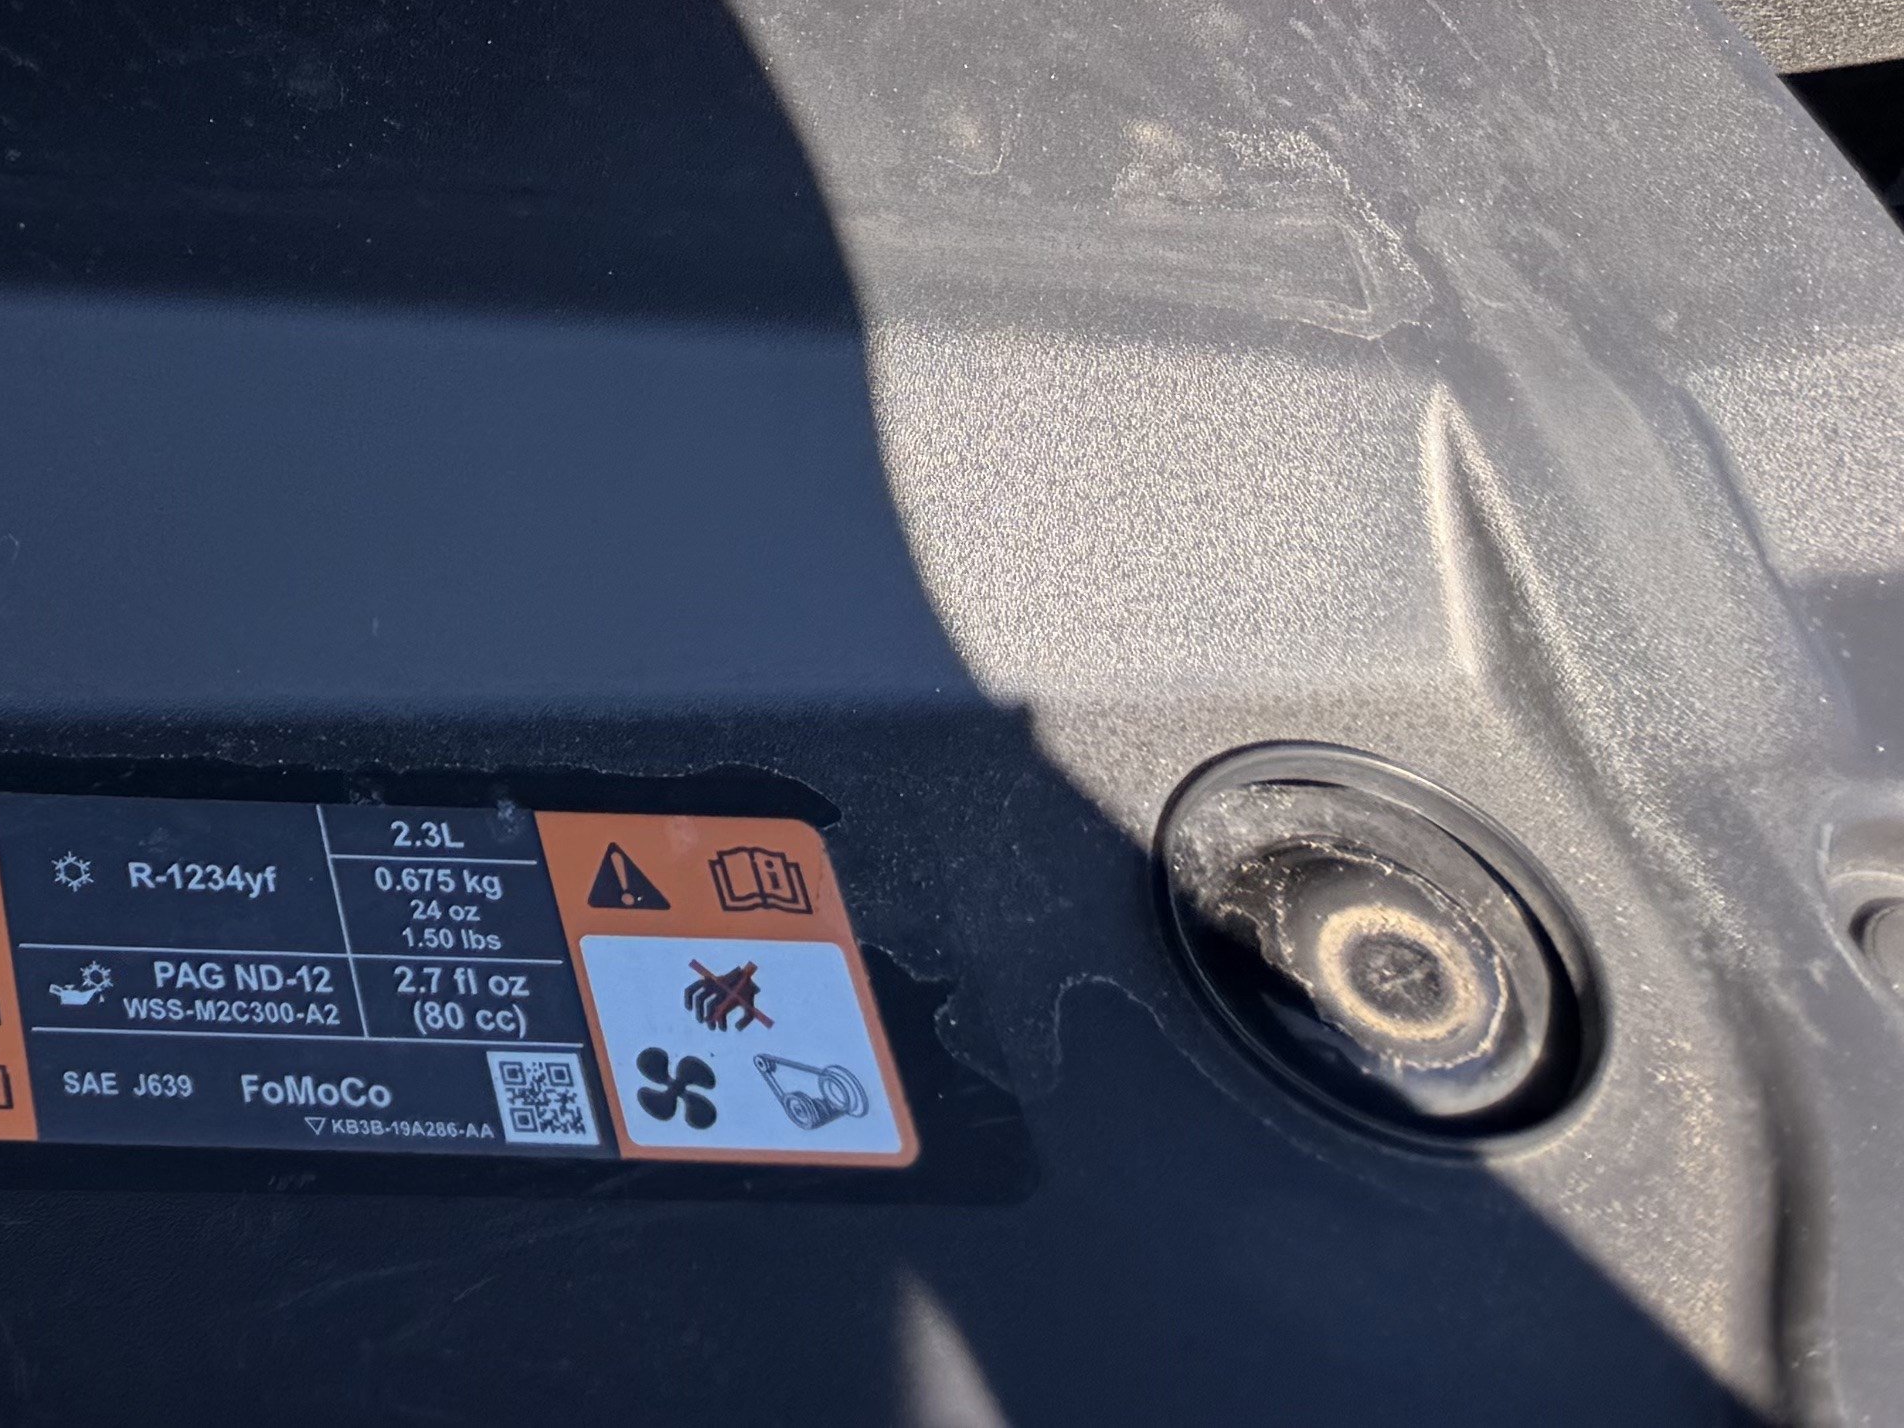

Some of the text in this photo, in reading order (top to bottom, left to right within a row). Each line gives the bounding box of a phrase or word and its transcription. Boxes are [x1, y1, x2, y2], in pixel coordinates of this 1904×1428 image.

[390, 819, 465, 851] 2.3L
[128, 862, 279, 898] R-1234yf
[373, 867, 504, 903] 0.675 kg
[409, 900, 481, 922] 24 oz
[401, 927, 502, 952] 1.50 lbs
[154, 962, 334, 995] PAG ND-12
[395, 966, 531, 999] 2.7 fl oz
[122, 998, 340, 1028] WSS-M2C300-A2
[413, 1000, 528, 1038] (80 cc)
[63, 1071, 193, 1098] SAE J639
[242, 1075, 392, 1109] FoMoCo
[330, 1116, 495, 1141] KB3B-19A286-AA
